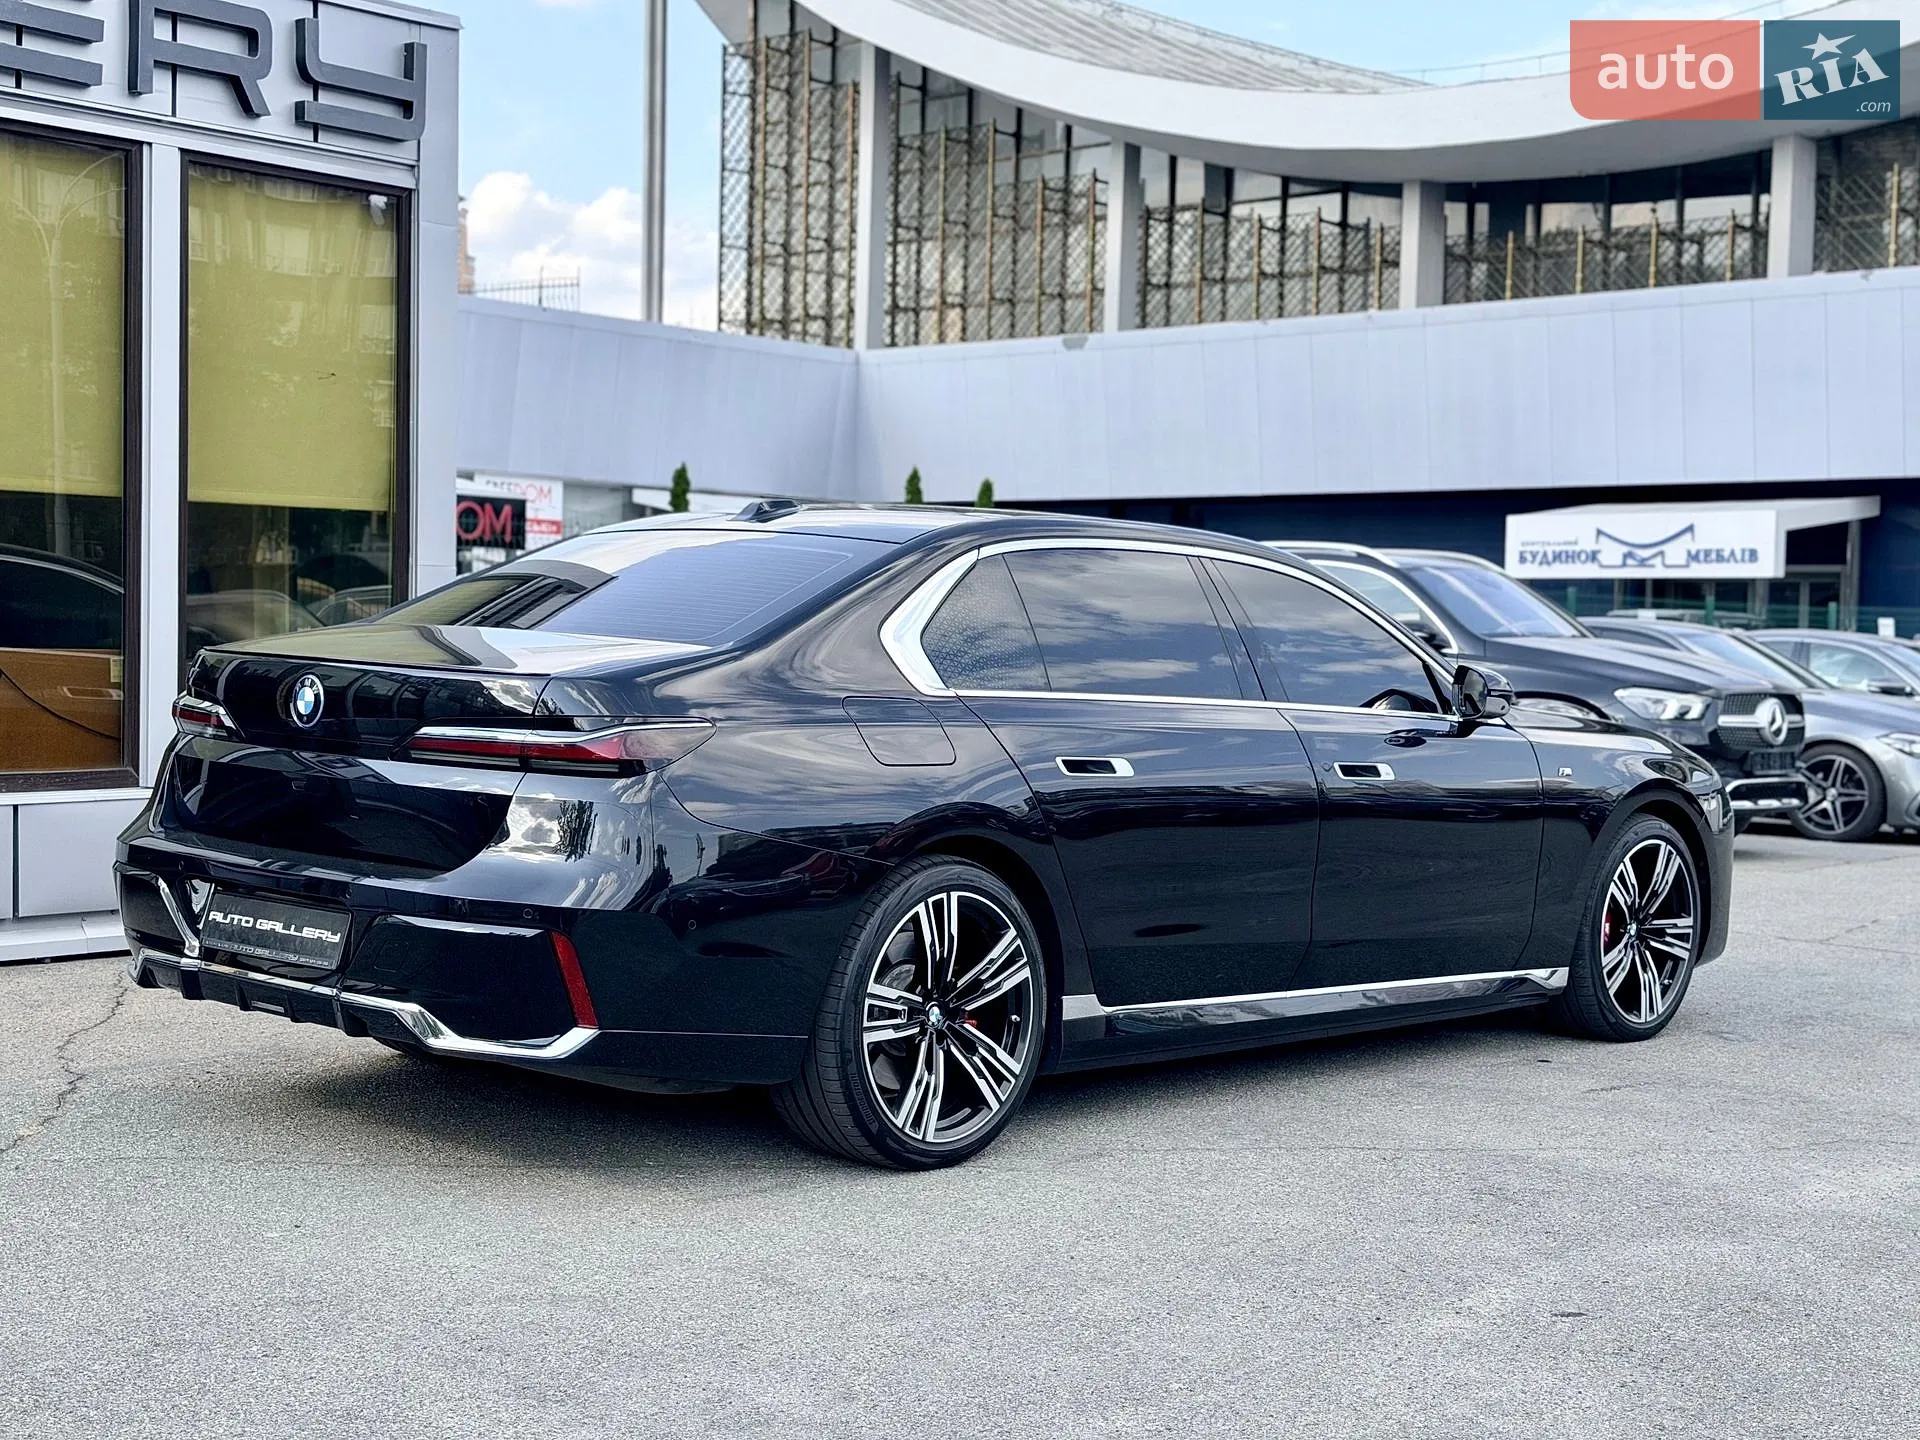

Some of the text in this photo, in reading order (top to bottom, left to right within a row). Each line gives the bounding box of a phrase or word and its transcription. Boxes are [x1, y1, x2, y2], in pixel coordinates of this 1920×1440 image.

[1518, 548, 1759, 566] БУДИНОК МЕБЛІВ
[208, 911, 342, 943] AUTO GALLERY
